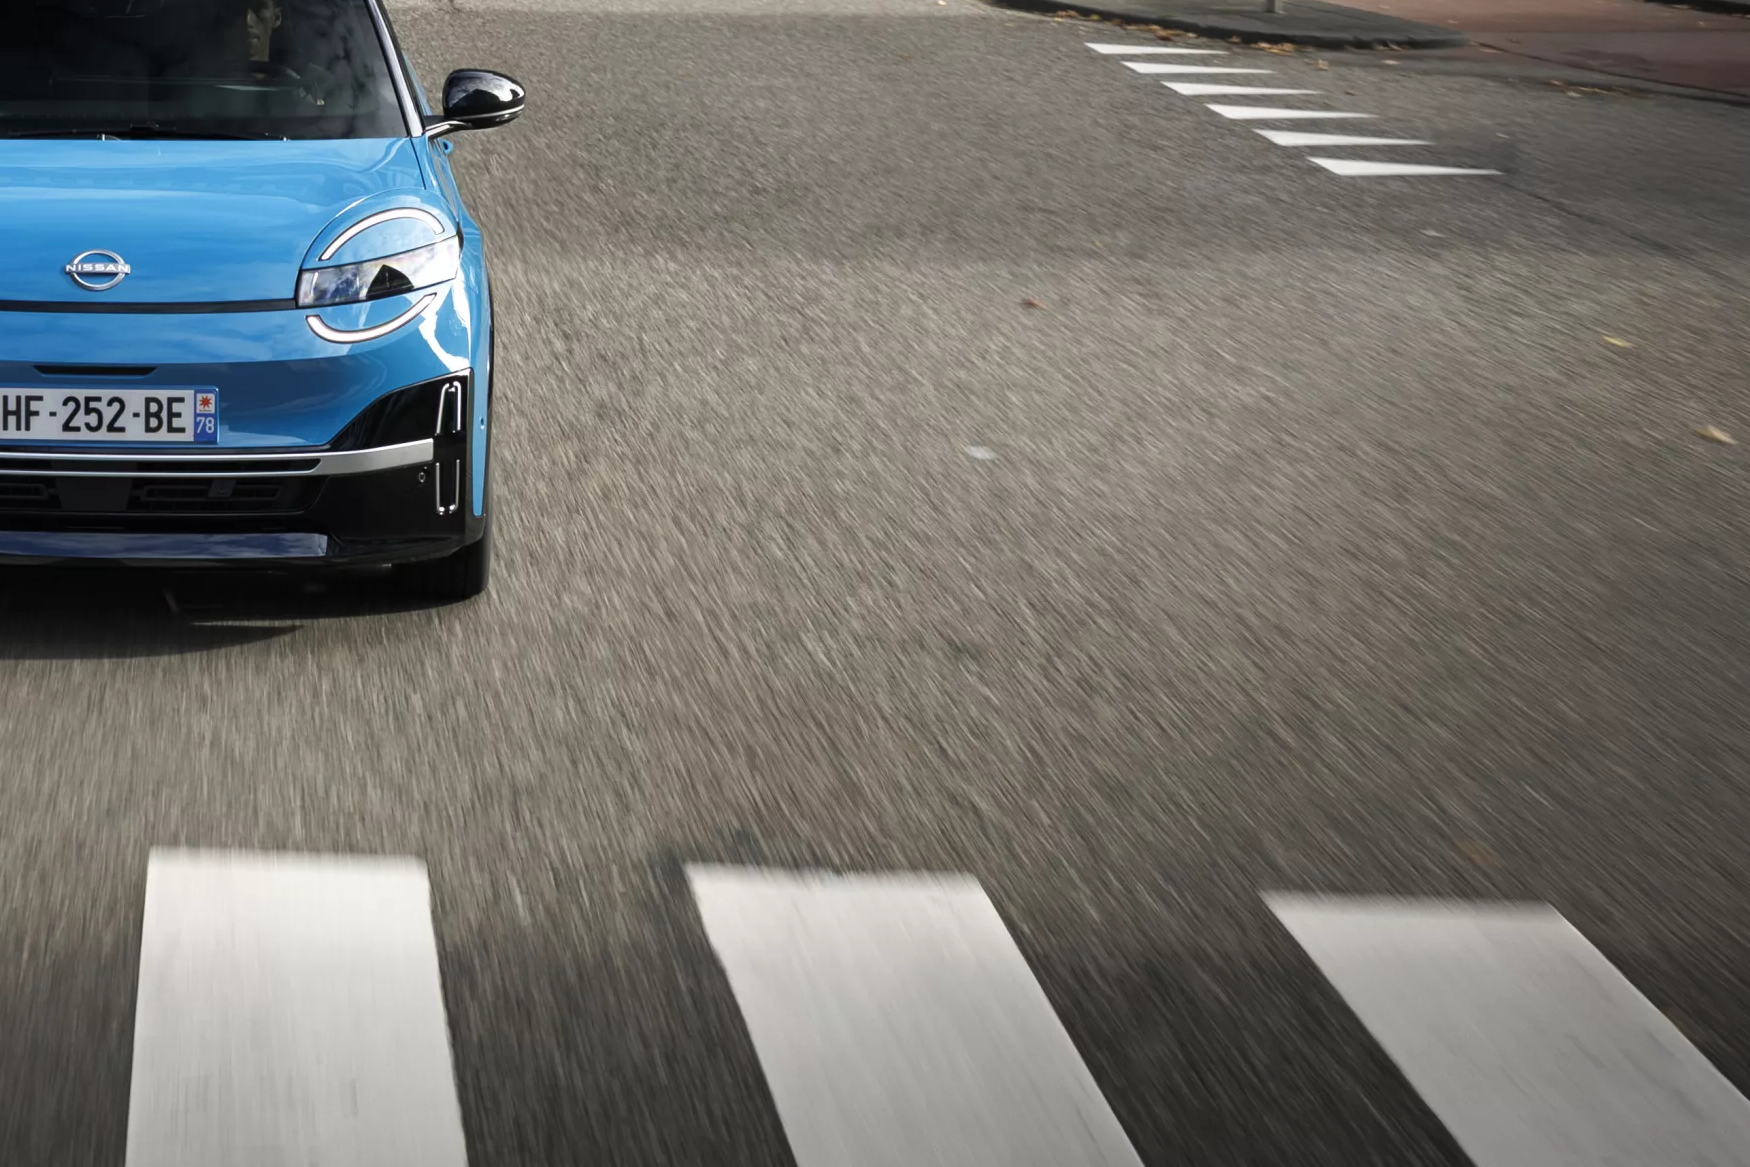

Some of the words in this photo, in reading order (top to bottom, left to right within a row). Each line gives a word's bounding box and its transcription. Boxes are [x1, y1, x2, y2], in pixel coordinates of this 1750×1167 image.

[66, 264, 128, 272] NISSAN
[2, 394, 186, 433] HF-252-BE
[196, 416, 215, 434] 78
